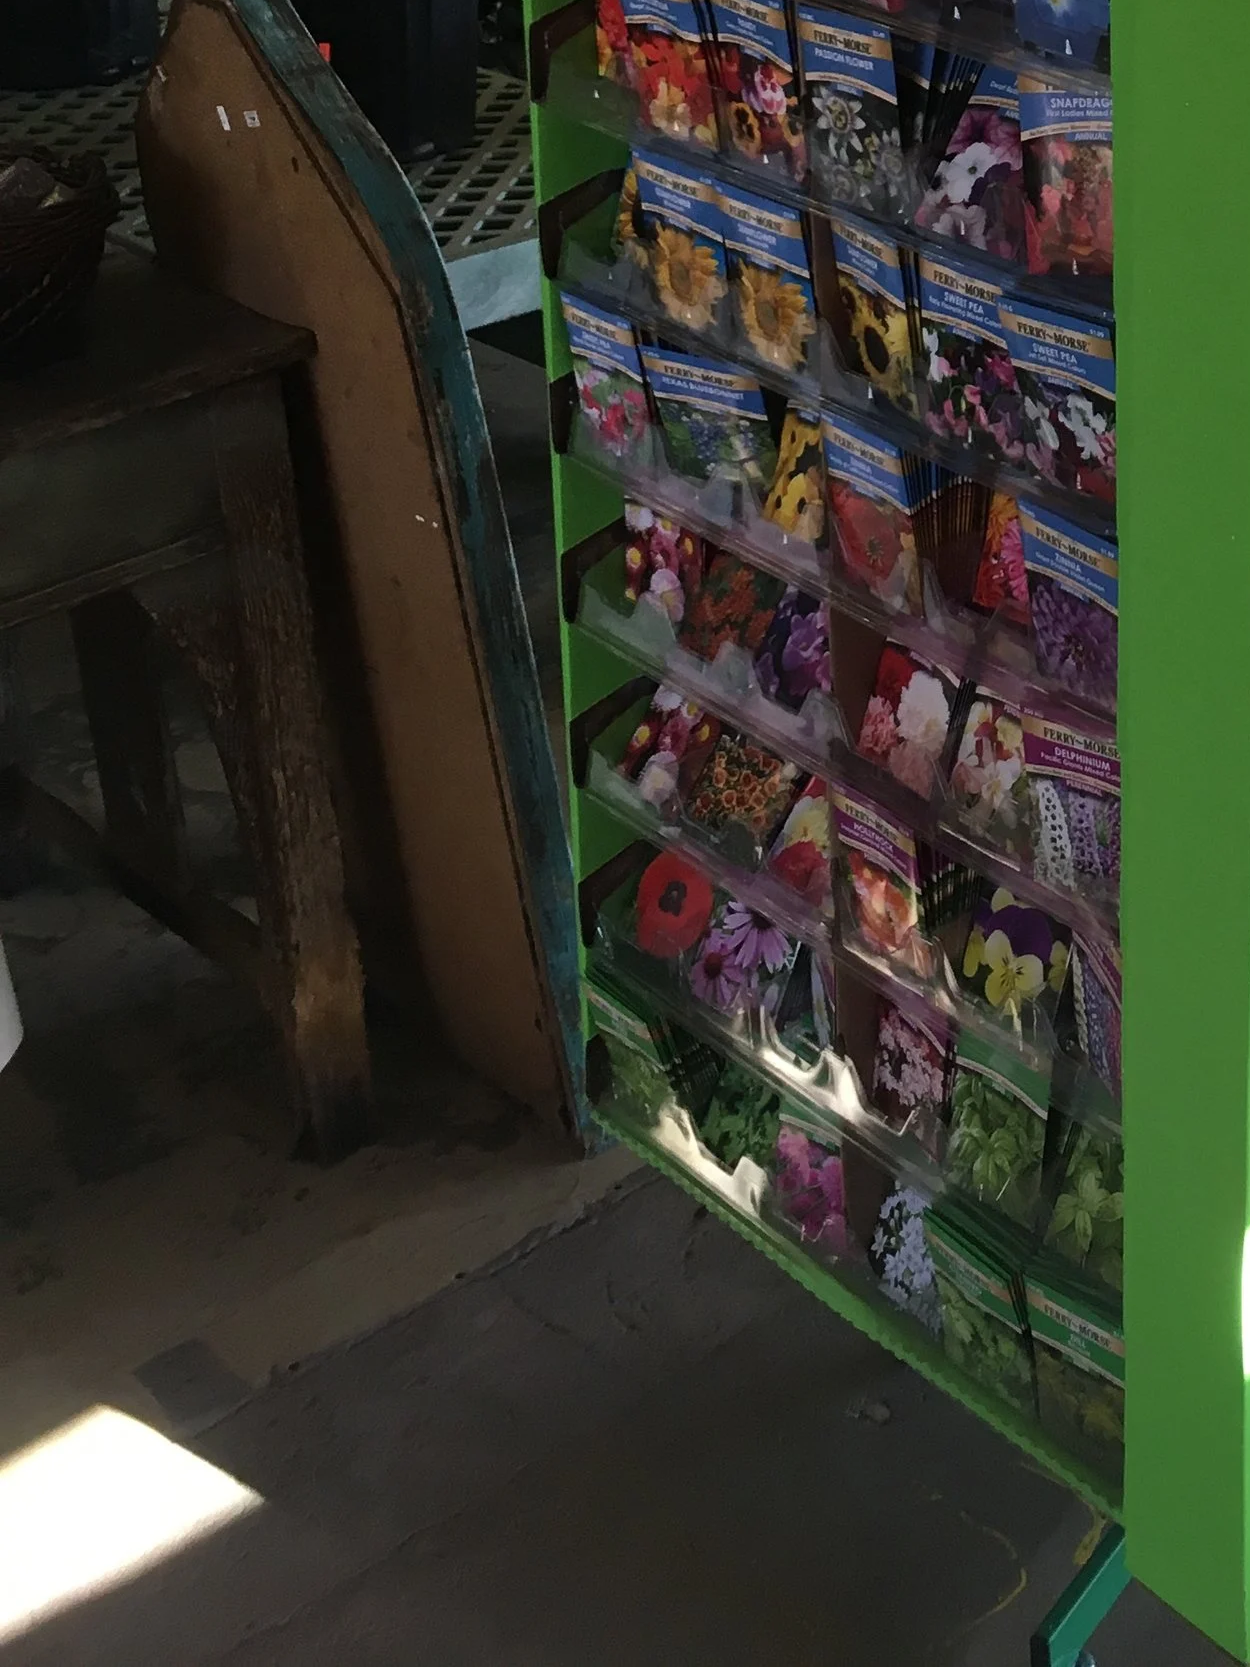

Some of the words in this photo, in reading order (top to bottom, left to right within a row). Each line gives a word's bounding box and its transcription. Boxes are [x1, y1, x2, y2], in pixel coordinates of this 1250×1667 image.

[1074, 132, 1108, 140] ANNUAL
[944, 292, 967, 309] SWEET
[967, 301, 985, 315] PEA
[1032, 342, 1058, 359] SWEET
[1059, 349, 1078, 363] PEA
[1054, 747, 1111, 771] DELPHINIUM
